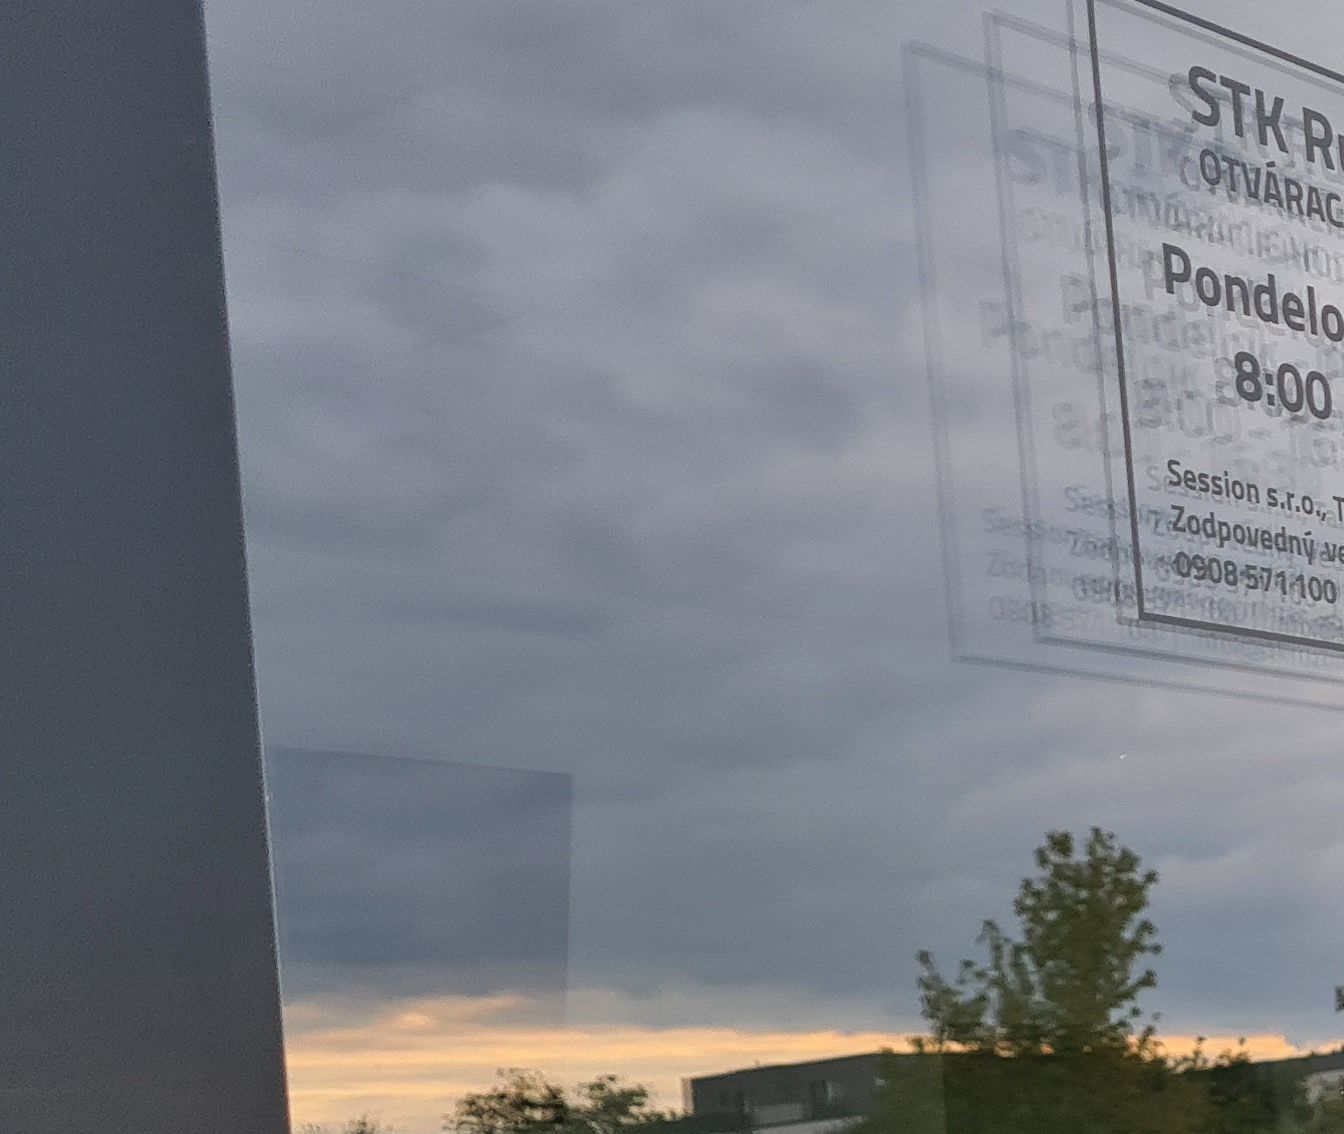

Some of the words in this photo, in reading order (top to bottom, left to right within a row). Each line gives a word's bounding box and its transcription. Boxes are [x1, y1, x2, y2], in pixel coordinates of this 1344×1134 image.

[1188, 65, 1289, 154] STK
[1234, 351, 1333, 420] 8:00
[1167, 459, 1260, 505] Session
[1266, 486, 1327, 523] s.r.o.,
[1170, 505, 1315, 566] Zodpovedný
[1174, 552, 1239, 587] 0908
[1244, 564, 1289, 597] 571
[1295, 574, 1338, 605] 100
